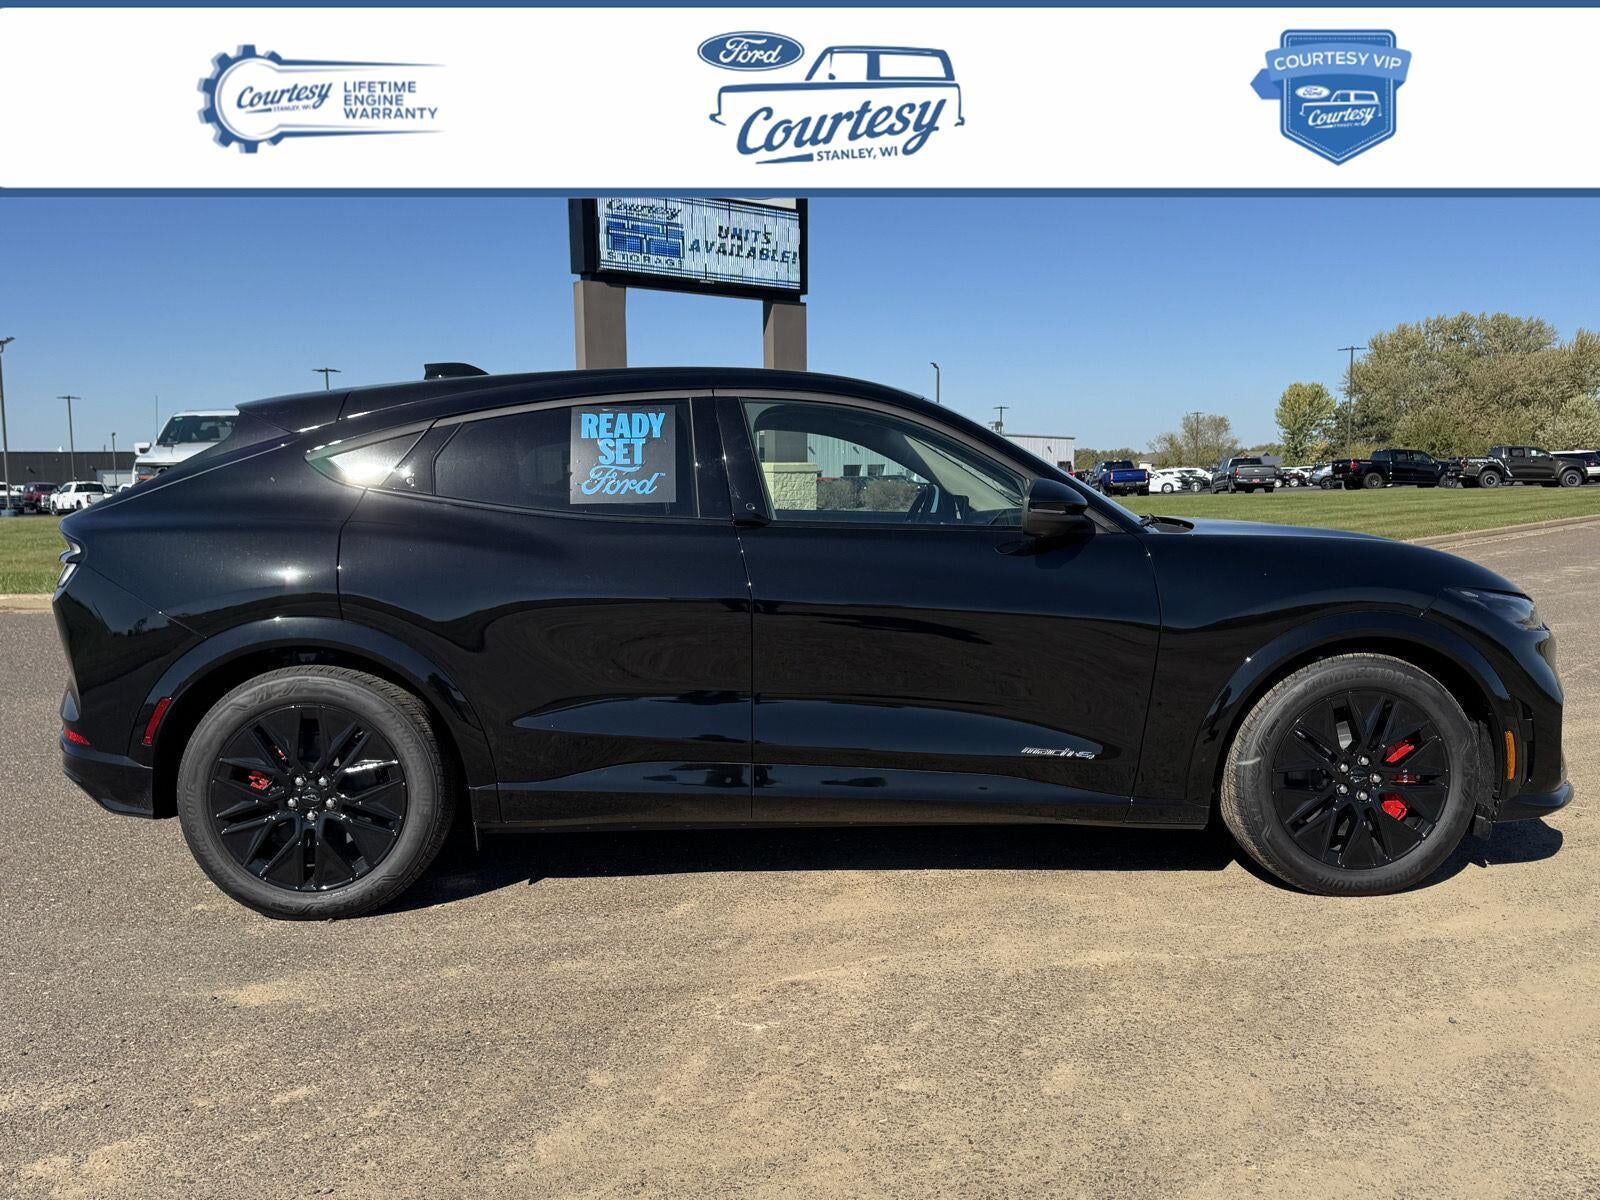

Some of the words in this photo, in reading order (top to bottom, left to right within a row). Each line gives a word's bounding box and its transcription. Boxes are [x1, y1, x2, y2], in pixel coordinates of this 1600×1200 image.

[717, 225, 773, 245] UNITS
[688, 238, 798, 264] AVAILABLE!
[580, 412, 666, 439] READY
[597, 438, 646, 465] SET
